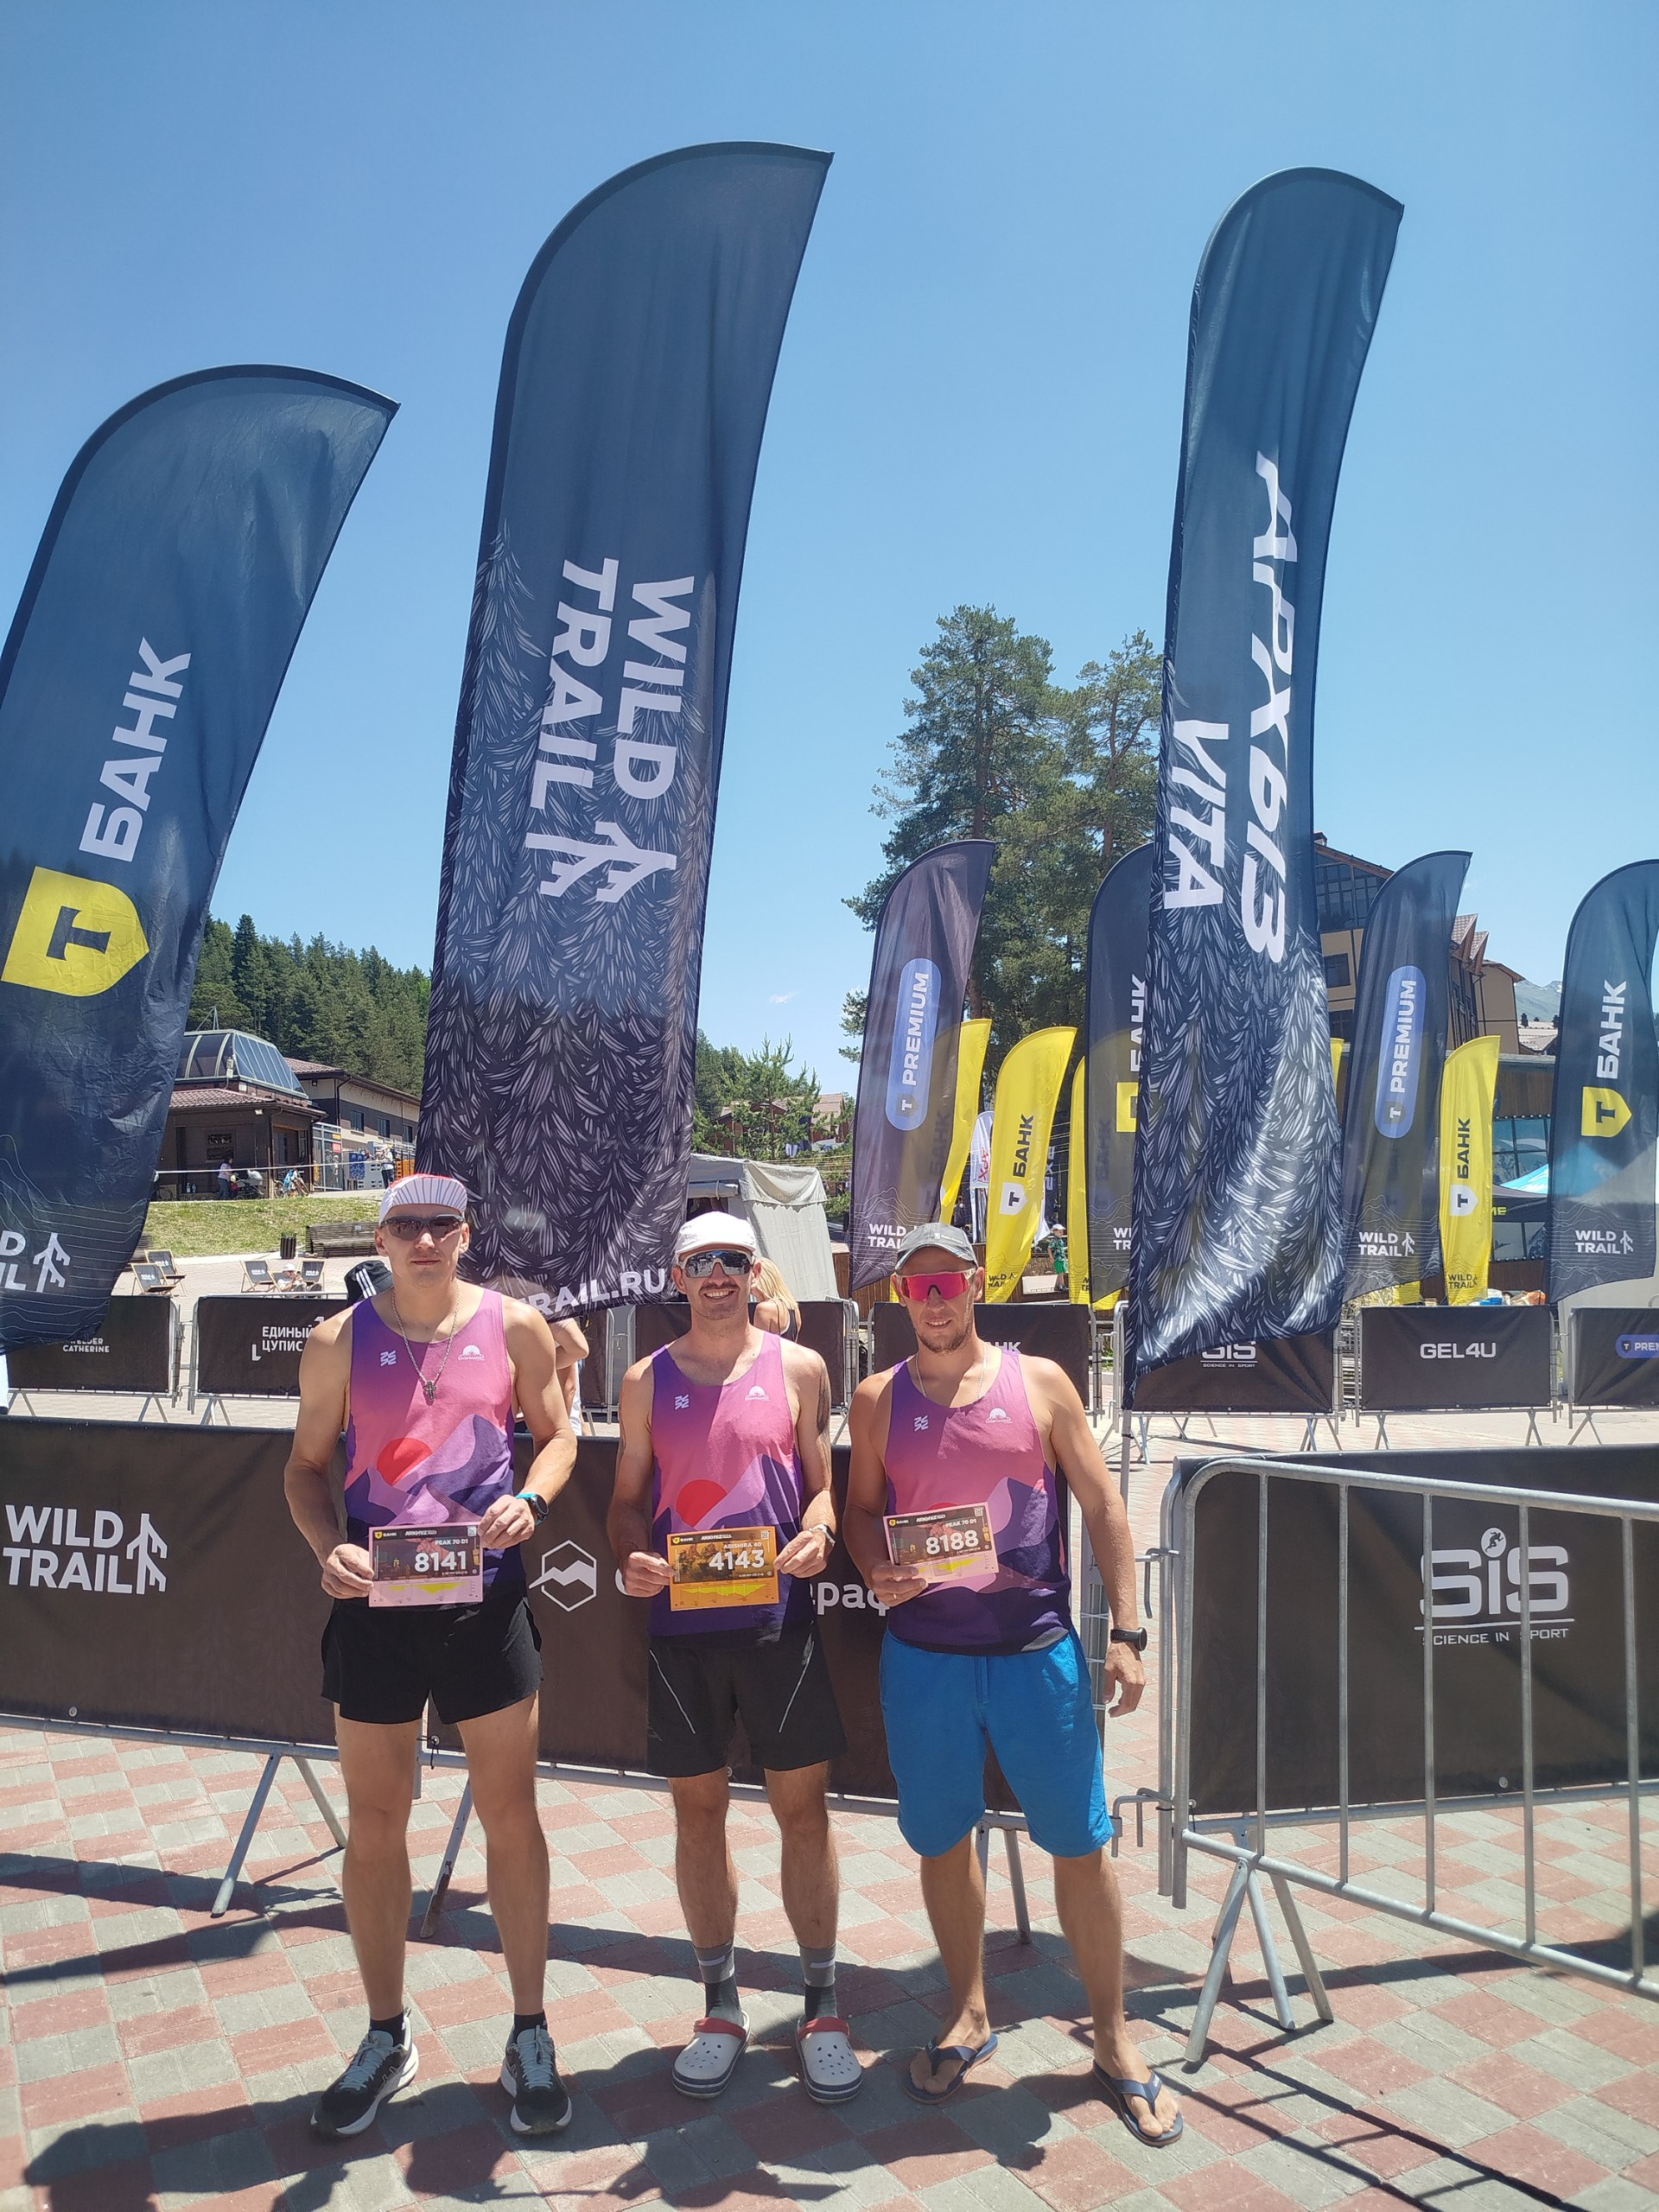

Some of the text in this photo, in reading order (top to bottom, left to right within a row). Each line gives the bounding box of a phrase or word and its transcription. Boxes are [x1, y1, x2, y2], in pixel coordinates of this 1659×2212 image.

[530, 557, 620, 810] TRAIL
[613, 575, 695, 799] WILD
[79, 637, 191, 861] БАНК
[1163, 720, 1229, 909] VITA
[902, 972, 929, 1085] PREMIUM
[1389, 980, 1417, 1093] PREMIUM
[1596, 979, 1627, 1079] БАНК
[1013, 1113, 1034, 1178] БАНК
[1457, 1117, 1471, 1179] БАНК
[868, 1223, 906, 1236] WILD
[1113, 1227, 1132, 1238] WI
[1358, 1231, 1399, 1244] WILD
[1574, 1230, 1617, 1242] WILD
[868, 1236, 900, 1249] TRAI
[1357, 1243, 1402, 1257] TRAIL
[1574, 1242, 1621, 1255] TRAIL
[62, 1344, 111, 1353] CATHERINE
[262, 1339, 303, 1353] ЦУПИС
[1420, 1342, 1497, 1359] GEL4U
[1634, 1342, 1659, 1351] PRE
[5, 1504, 124, 1548] WILD
[925, 1529, 979, 1554] 8188
[3, 1547, 133, 1594] TRAIL
[415, 1550, 467, 1573] 8141
[709, 1548, 765, 1571] 4143
[1495, 1631, 1510, 1643] IN
[1520, 1628, 1569, 1640] PORT
